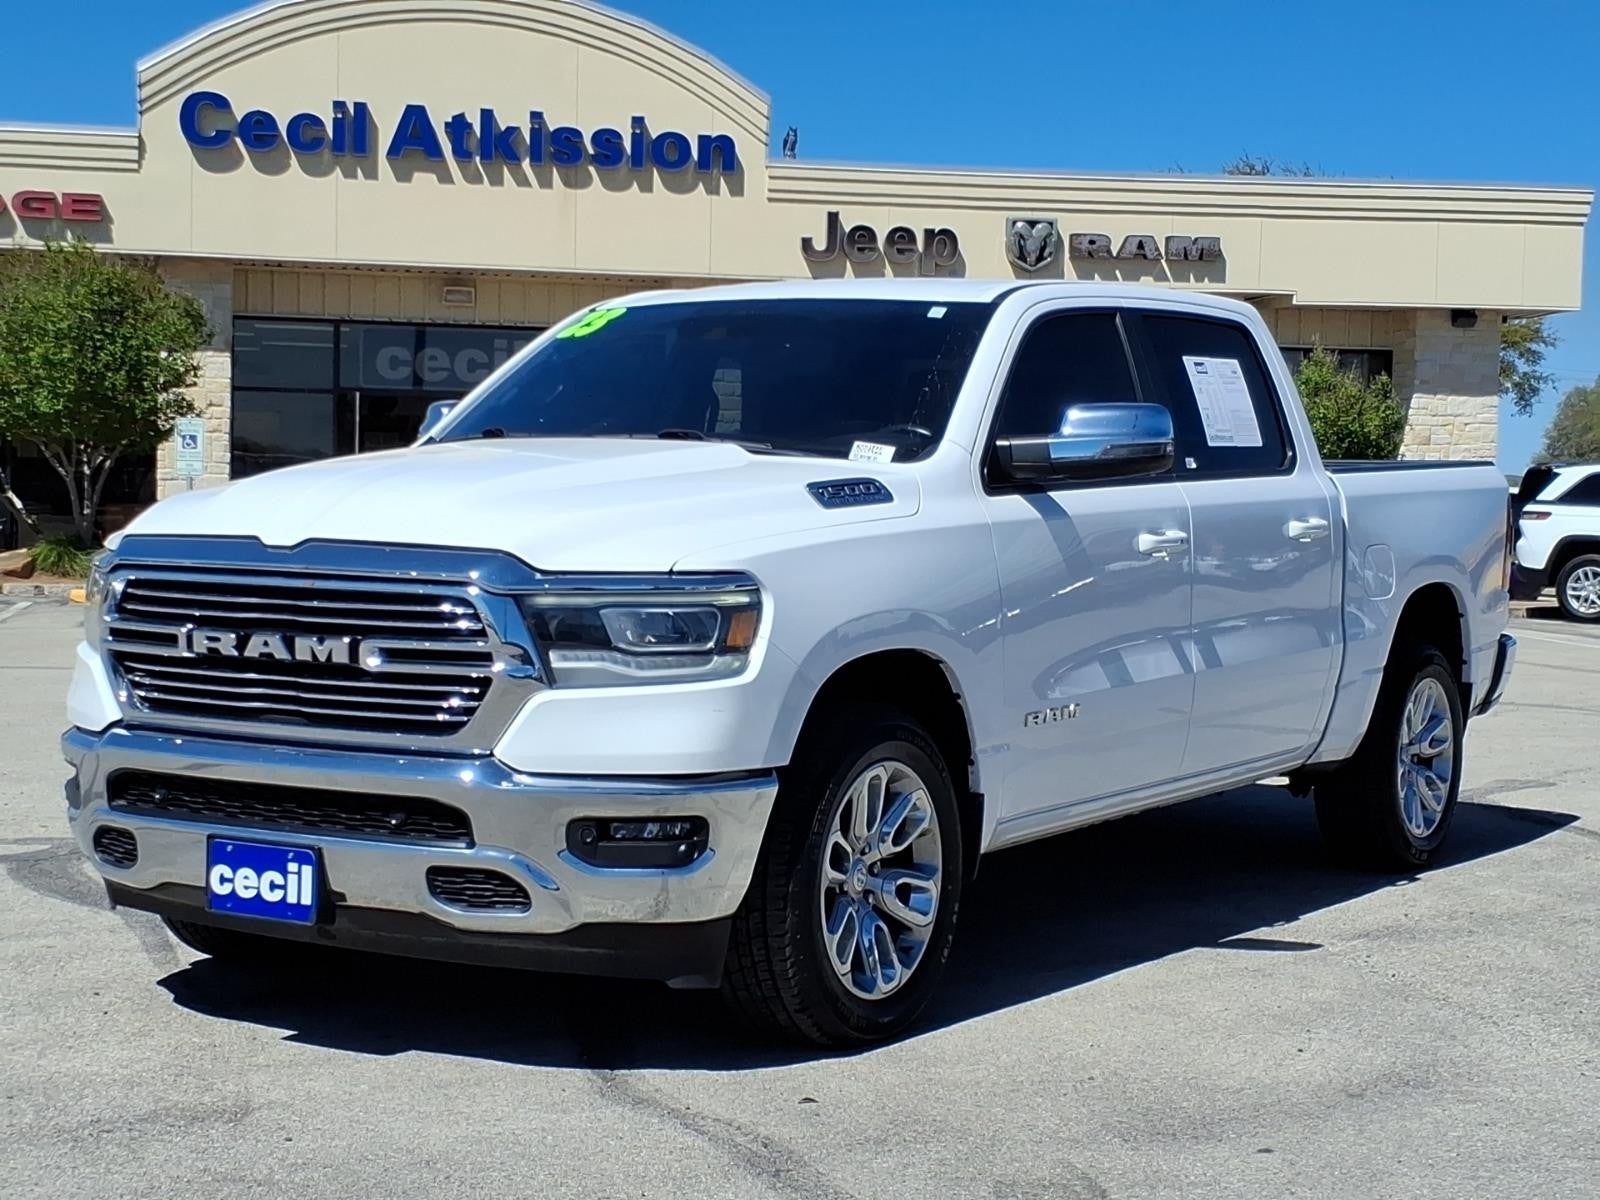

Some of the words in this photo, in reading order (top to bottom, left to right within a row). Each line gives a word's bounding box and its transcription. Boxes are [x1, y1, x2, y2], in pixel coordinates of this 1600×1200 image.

[179, 91, 368, 157] Cecil
[385, 104, 735, 173] Atkission
[0, 190, 102, 221] GE
[801, 211, 959, 275] Jeep
[1069, 233, 1221, 261] RAM
[376, 338, 527, 383] ceci
[818, 483, 880, 498] 1500
[192, 629, 350, 664] RAM
[1023, 703, 1081, 727] RAM
[210, 862, 313, 906] cecil
